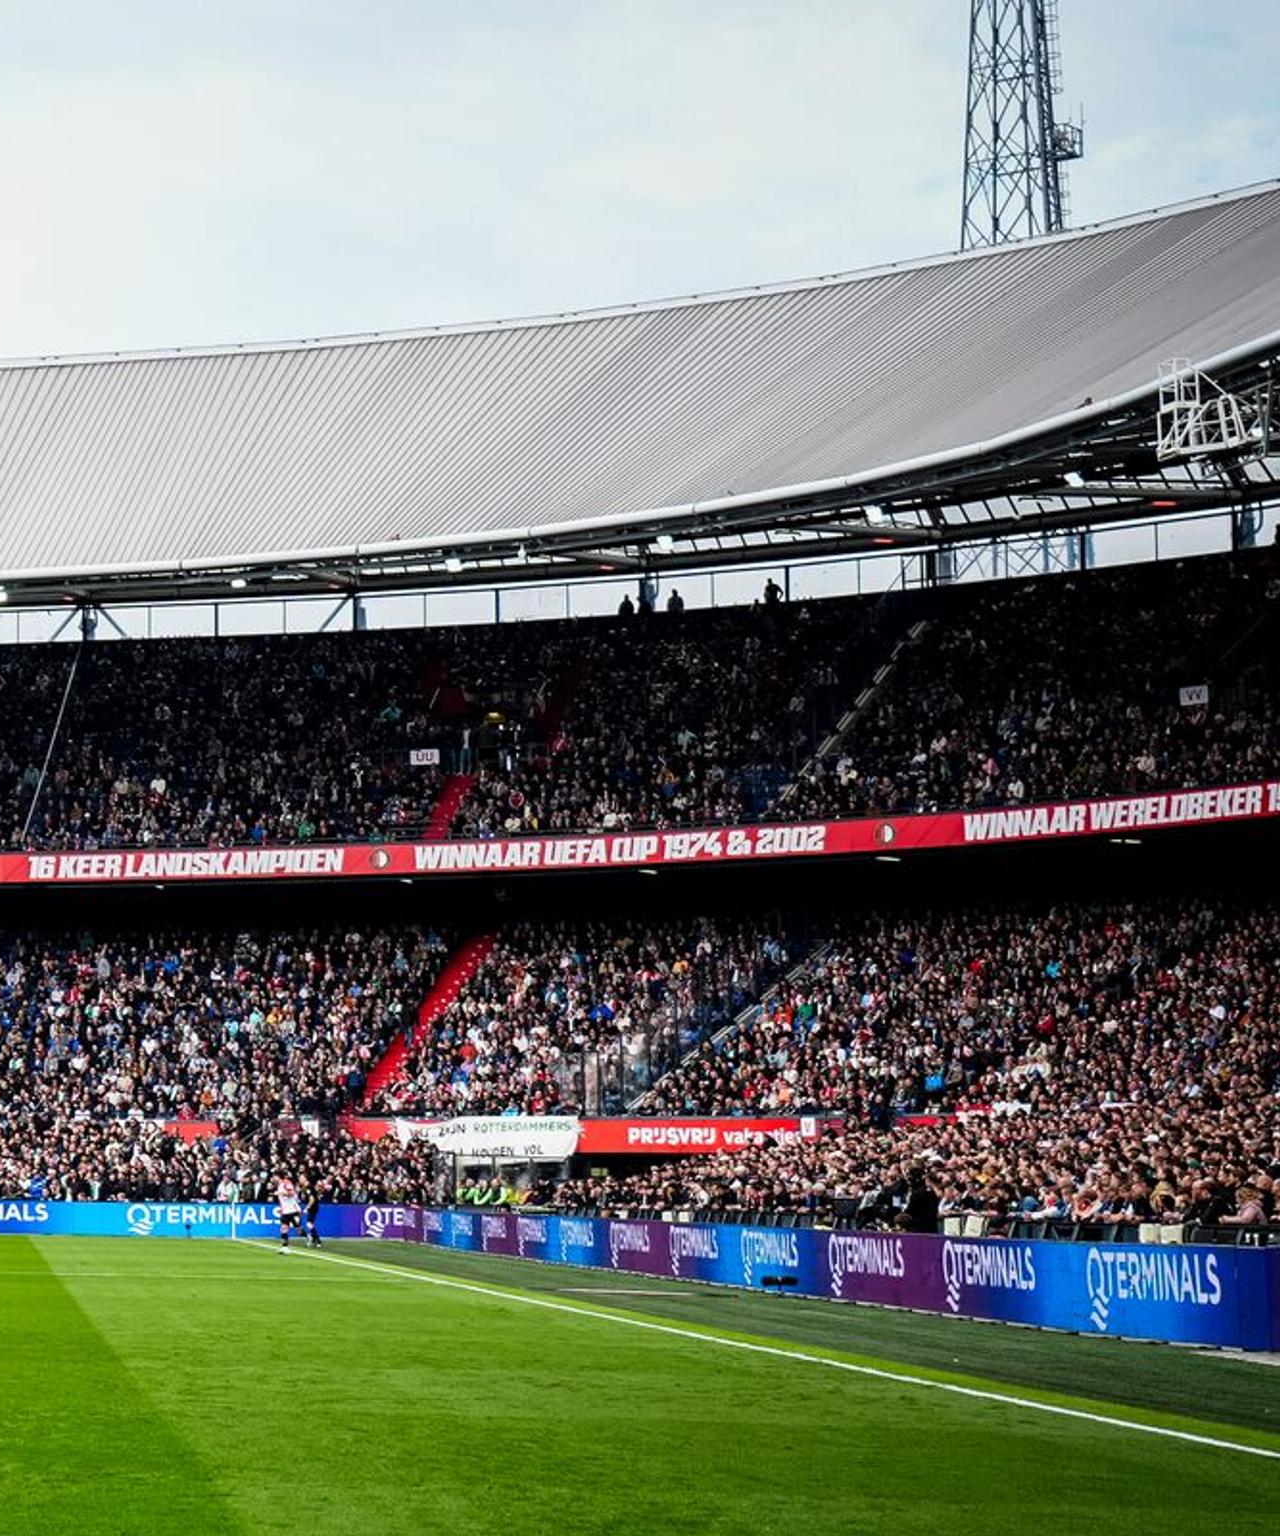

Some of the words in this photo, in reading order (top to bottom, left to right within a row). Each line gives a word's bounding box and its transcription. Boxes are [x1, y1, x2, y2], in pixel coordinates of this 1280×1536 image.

[416, 751, 434, 763] UU
[964, 805, 1087, 842] WINNAAR
[1090, 785, 1263, 831] WERELDBEKER
[28, 856, 56, 879] 16
[57, 855, 122, 879] KEER
[123, 849, 345, 878] LANDSKAMPIOEN
[414, 842, 542, 870] WINNAAR
[543, 838, 608, 866] UEFA
[610, 836, 659, 863] CUP
[662, 832, 723, 860] 1974
[727, 830, 752, 856] &
[754, 826, 827, 855] 2002
[828, 1233, 905, 1297] QTERMINALS
[942, 1239, 1036, 1312] QTERMINALS
[1086, 1246, 1222, 1331] QTERMINALS
